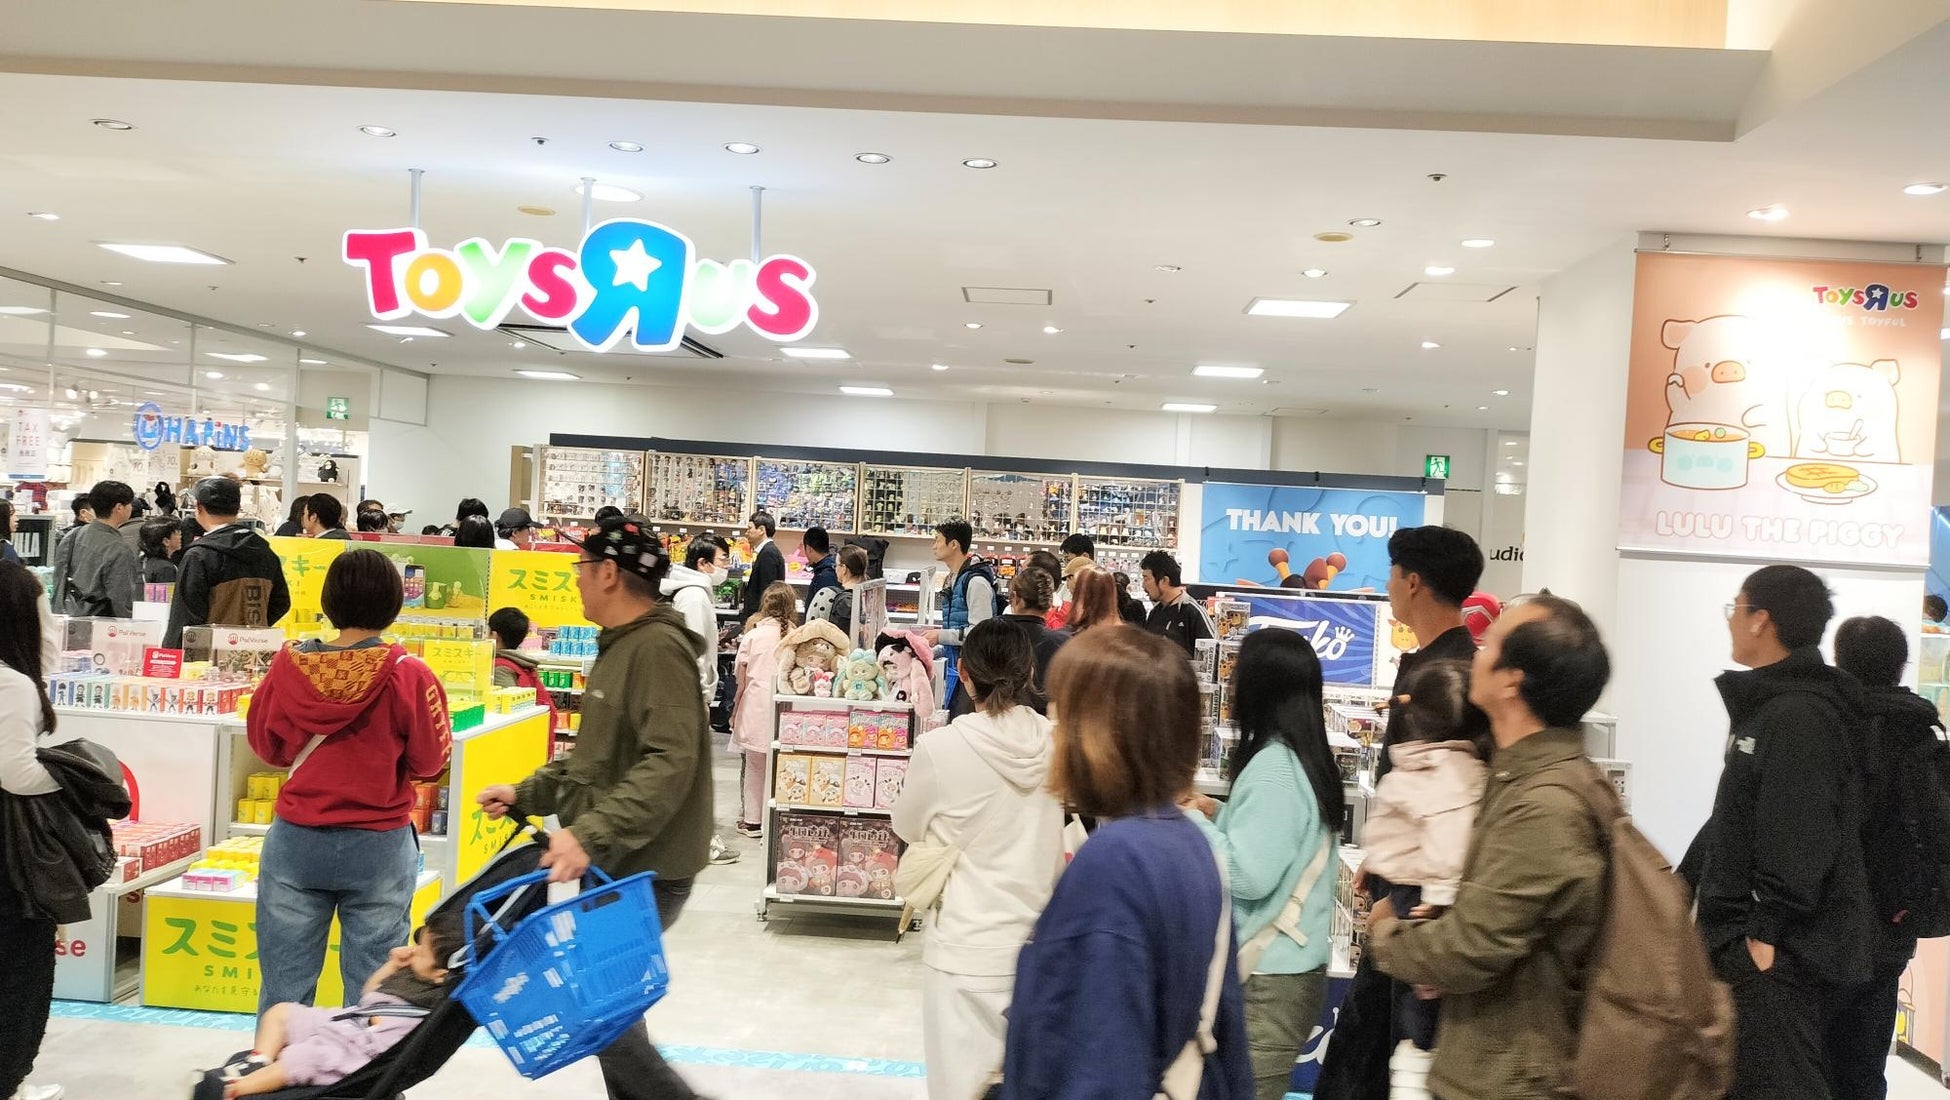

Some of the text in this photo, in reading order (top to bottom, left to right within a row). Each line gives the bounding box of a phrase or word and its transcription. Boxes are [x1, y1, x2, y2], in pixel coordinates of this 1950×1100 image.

[1225, 508, 1397, 539] THANK YOU!
[1655, 510, 1906, 550] LULU THE PIGGY
